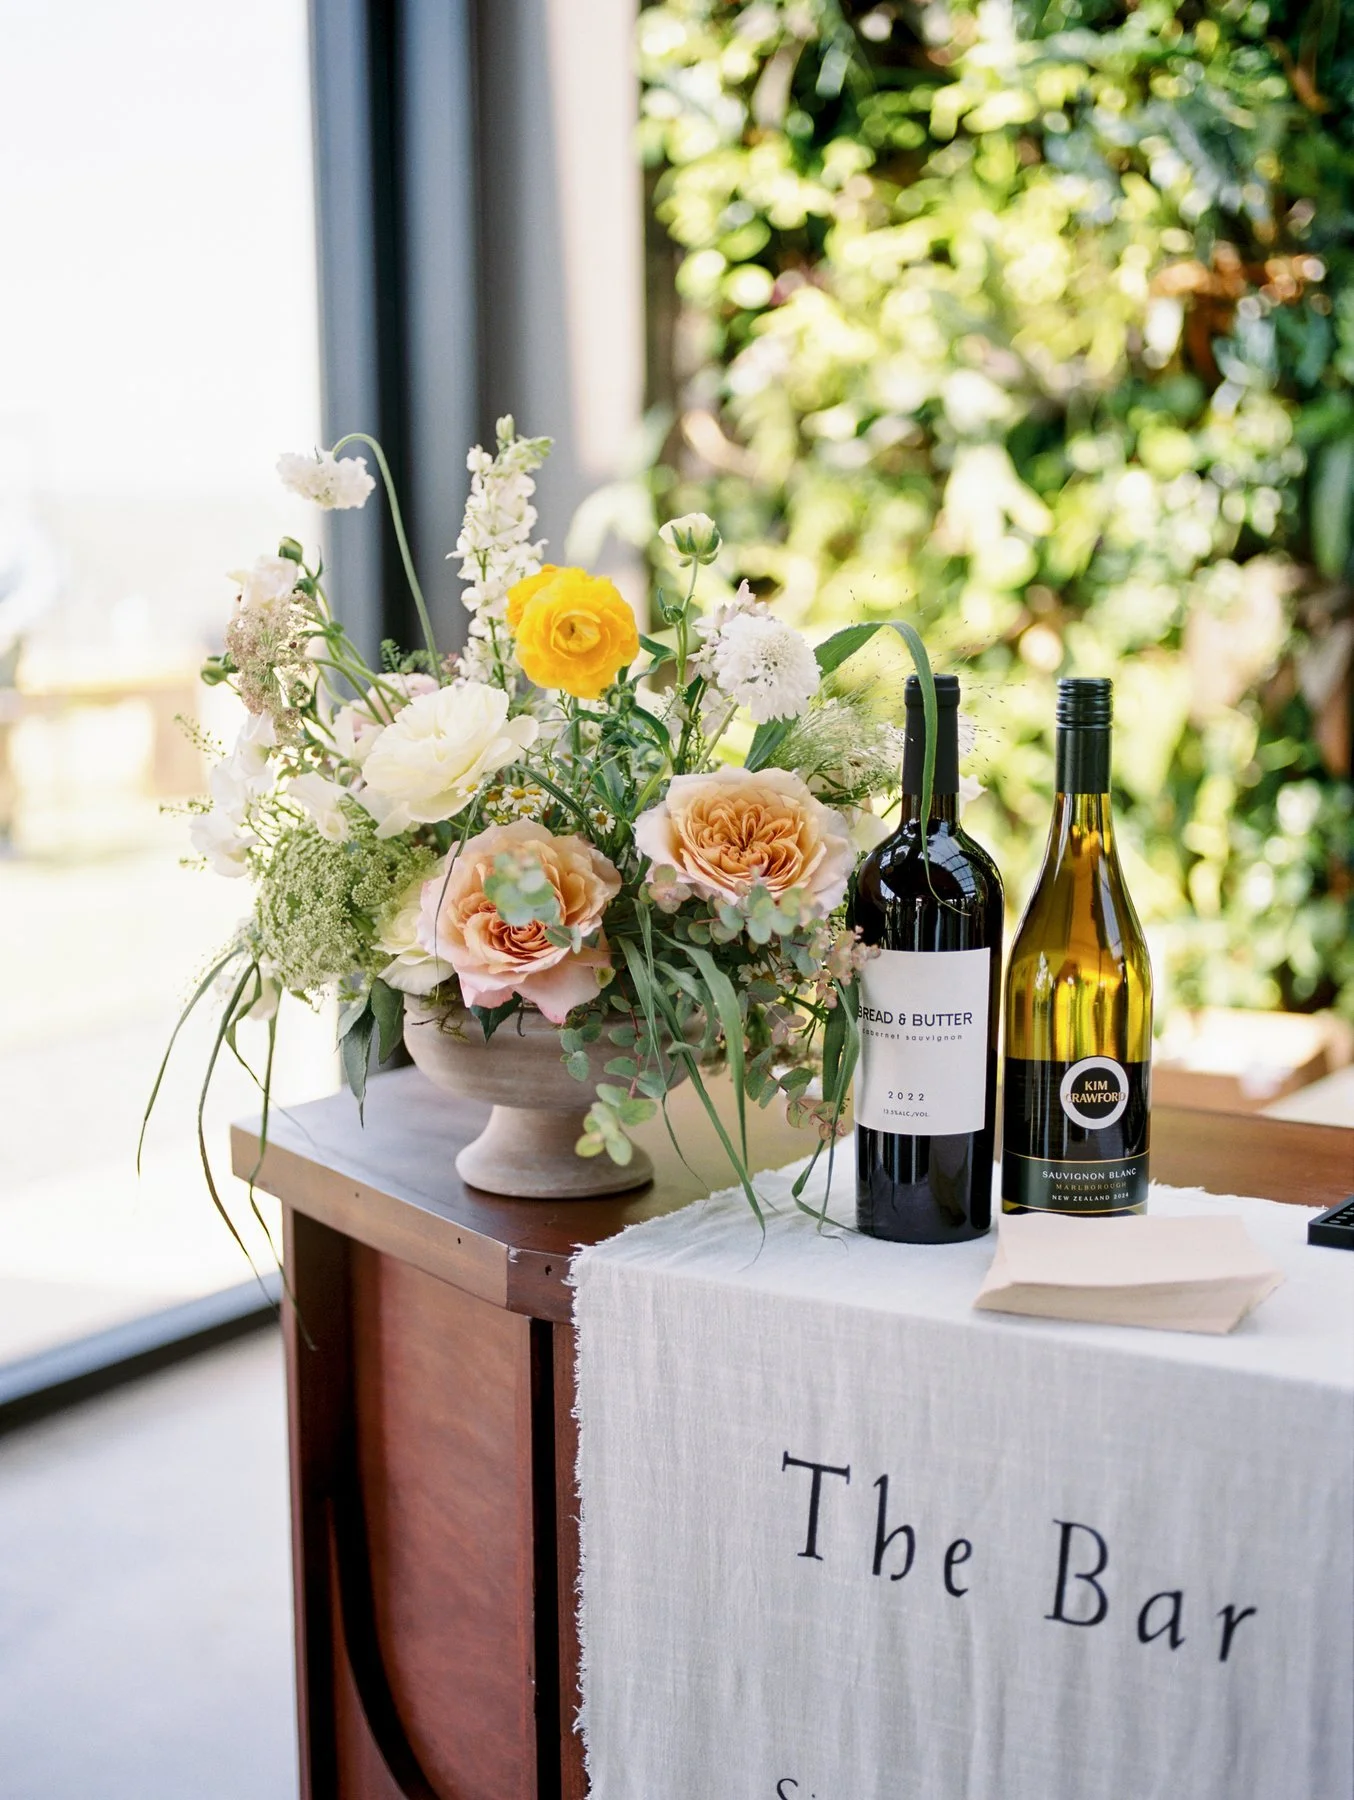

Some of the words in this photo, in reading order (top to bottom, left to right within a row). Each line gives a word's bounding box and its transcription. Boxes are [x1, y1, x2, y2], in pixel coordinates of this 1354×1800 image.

[898, 1013, 907, 1026] &
[912, 1011, 973, 1027] BUTTER
[905, 1034, 963, 1042] sauvignon
[1084, 1080, 1108, 1091] KIM
[888, 1091, 925, 1102] 2022
[1065, 1092, 1126, 1104] CRAWFORD
[1042, 1170, 1105, 1181] SAUVIGNON
[1109, 1167, 1137, 1179] BLANC
[1055, 1182, 1127, 1191] MARLBOROUGH
[1073, 1194, 1110, 1202] ZEALAND
[1113, 1192, 1129, 1200] 2024
[782, 1450, 974, 1599] The
[1044, 1518, 1258, 1663] Bar
